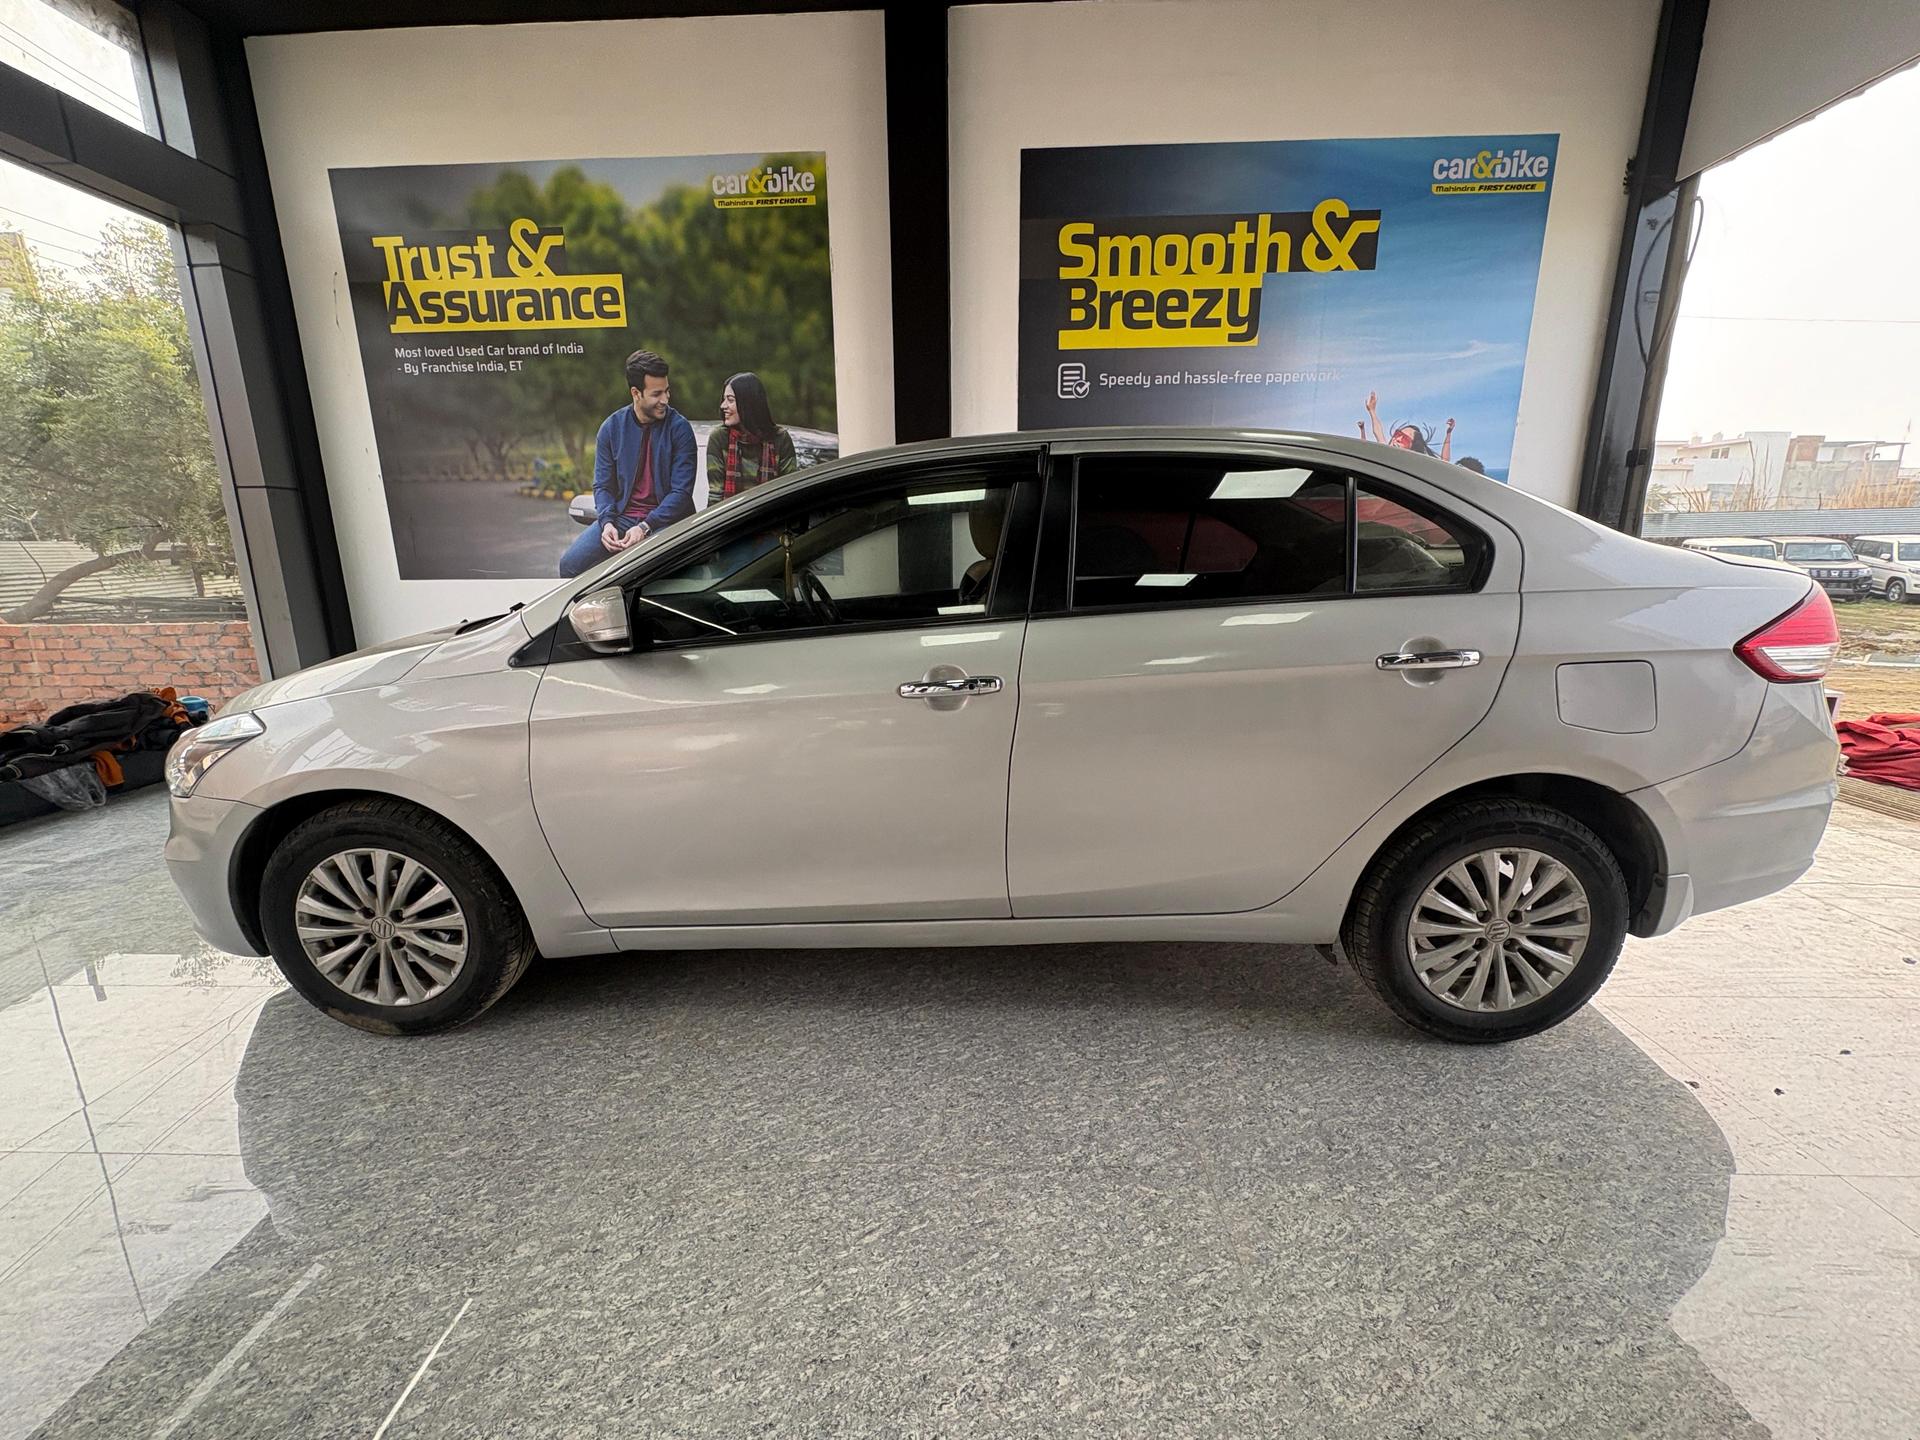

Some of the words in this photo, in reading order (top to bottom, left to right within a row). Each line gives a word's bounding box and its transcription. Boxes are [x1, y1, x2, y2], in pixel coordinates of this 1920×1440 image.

[1432, 149, 1549, 180] car&bike
[712, 166, 816, 196] car&bike
[1435, 185, 1476, 193] Mahindra
[1478, 183, 1505, 192] FIRST
[1504, 183, 1537, 191] CHOICE
[755, 198, 780, 206] FIRST
[779, 197, 808, 205] CHOICE
[372, 234, 495, 283] Trust
[507, 218, 565, 278] &
[1059, 214, 1291, 280] Smooth
[1301, 198, 1381, 273] &
[388, 281, 622, 326] Assurance
[1065, 278, 1263, 343] Breezy
[395, 347, 422, 359] Most
[424, 346, 454, 358] loved
[456, 345, 485, 357] Used
[487, 345, 505, 356] Car
[507, 344, 540, 355] brand
[542, 343, 554, 354] of
[556, 342, 584, 354] India
[404, 363, 419, 376] By
[421, 361, 474, 373] Franchise
[476, 360, 508, 373] India,
[509, 360, 524, 371] ET
[1100, 372, 1151, 388] Speedy
[1155, 372, 1181, 385] and
[1184, 370, 1262, 384] hassle-free
